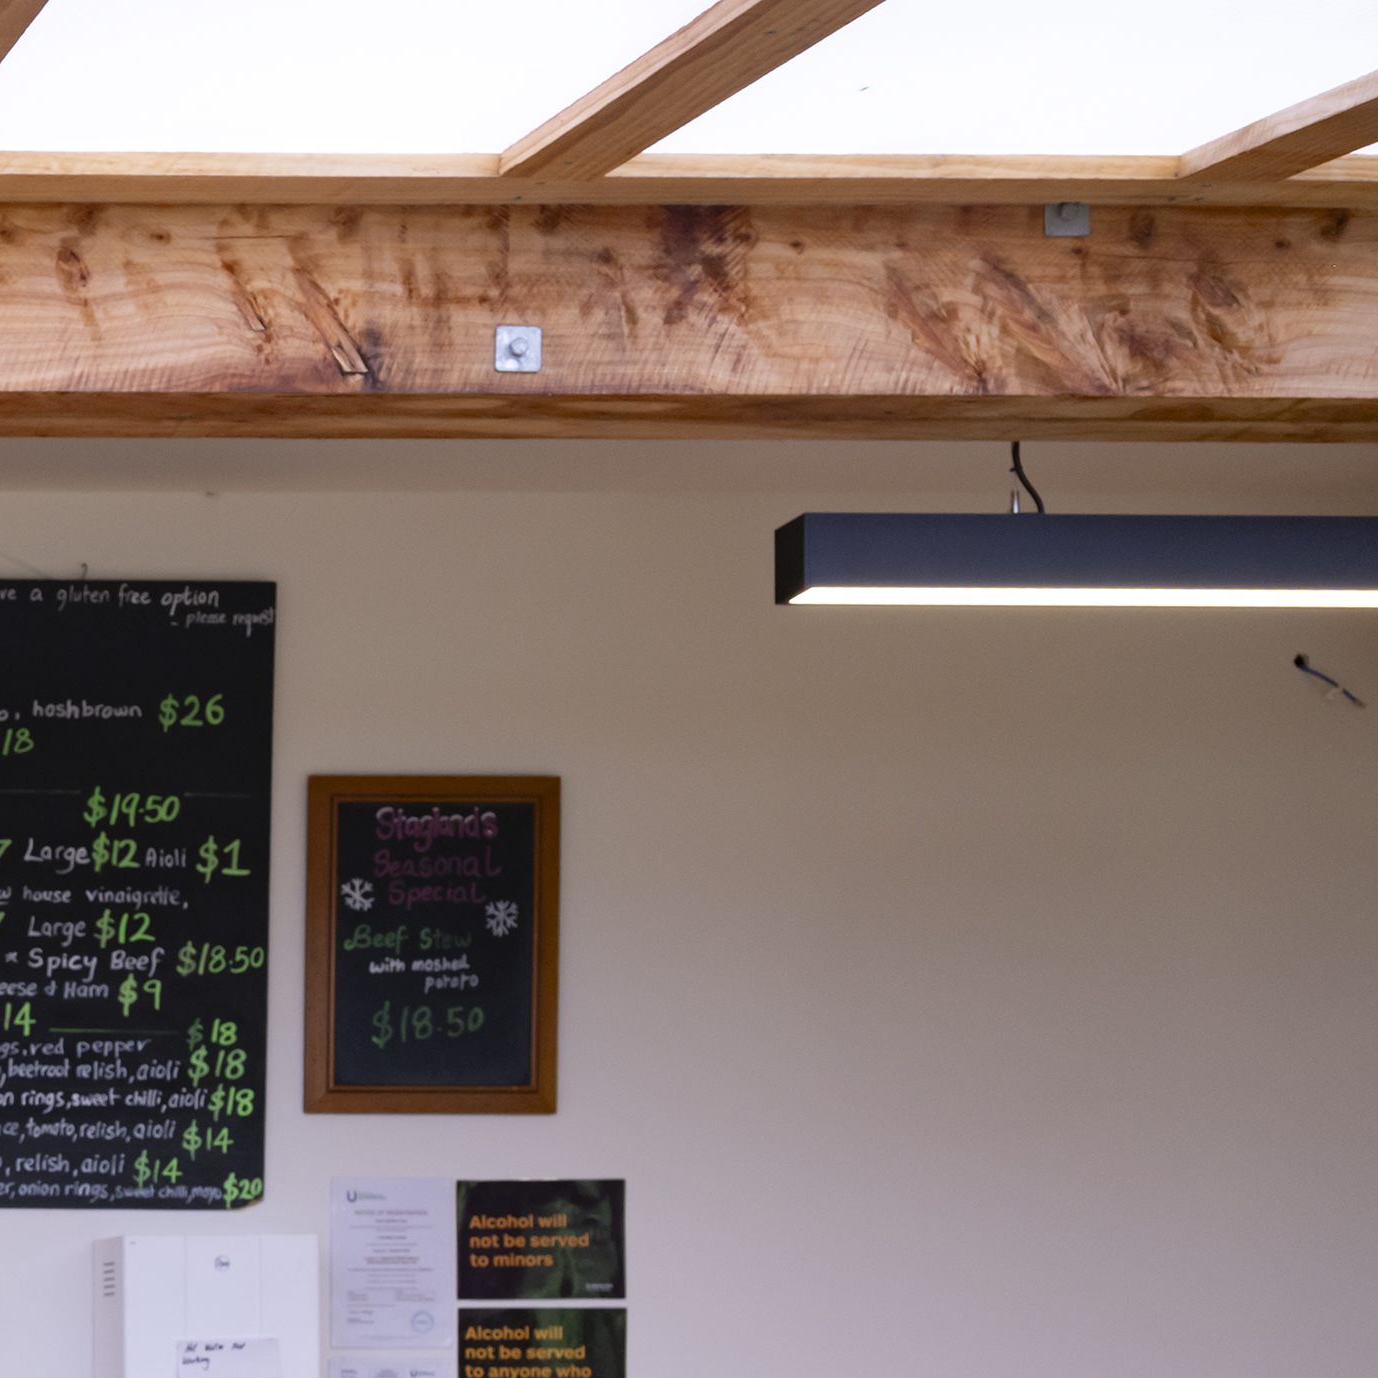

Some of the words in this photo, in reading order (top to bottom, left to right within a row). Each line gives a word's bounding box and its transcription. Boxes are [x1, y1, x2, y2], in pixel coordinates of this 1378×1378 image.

[30, 588, 43, 601] a
[56, 584, 110, 612] gluten
[118, 583, 151, 609] free
[160, 586, 219, 617] option
[158, 693, 225, 732] $26
[83, 786, 180, 828] $19.50
[376, 806, 499, 851] Staglands
[23, 837, 91, 874] Large
[92, 832, 141, 872] $12
[145, 848, 186, 868] Aioli
[196, 835, 251, 884] $1
[343, 924, 409, 955] Beef
[369, 957, 406, 974] with
[410, 954, 471, 972] mashed
[424, 974, 479, 994] potato
[371, 1000, 484, 1049] $18.50
[223, 1172, 263, 1209] $20
[469, 1214, 534, 1229] Alcohol
[538, 1214, 567, 1228] will
[469, 1234, 500, 1248] not
[503, 1233, 526, 1248] be
[530, 1233, 589, 1248] served
[470, 1253, 489, 1268] to
[493, 1252, 554, 1267] minors
[465, 1326, 530, 1340] Alcohol
[533, 1326, 563, 1340] will
[465, 1345, 495, 1359] not
[499, 1345, 522, 1359] be
[526, 1345, 586, 1359] served
[464, 1364, 484, 1378] to
[555, 1364, 592, 1378] who
